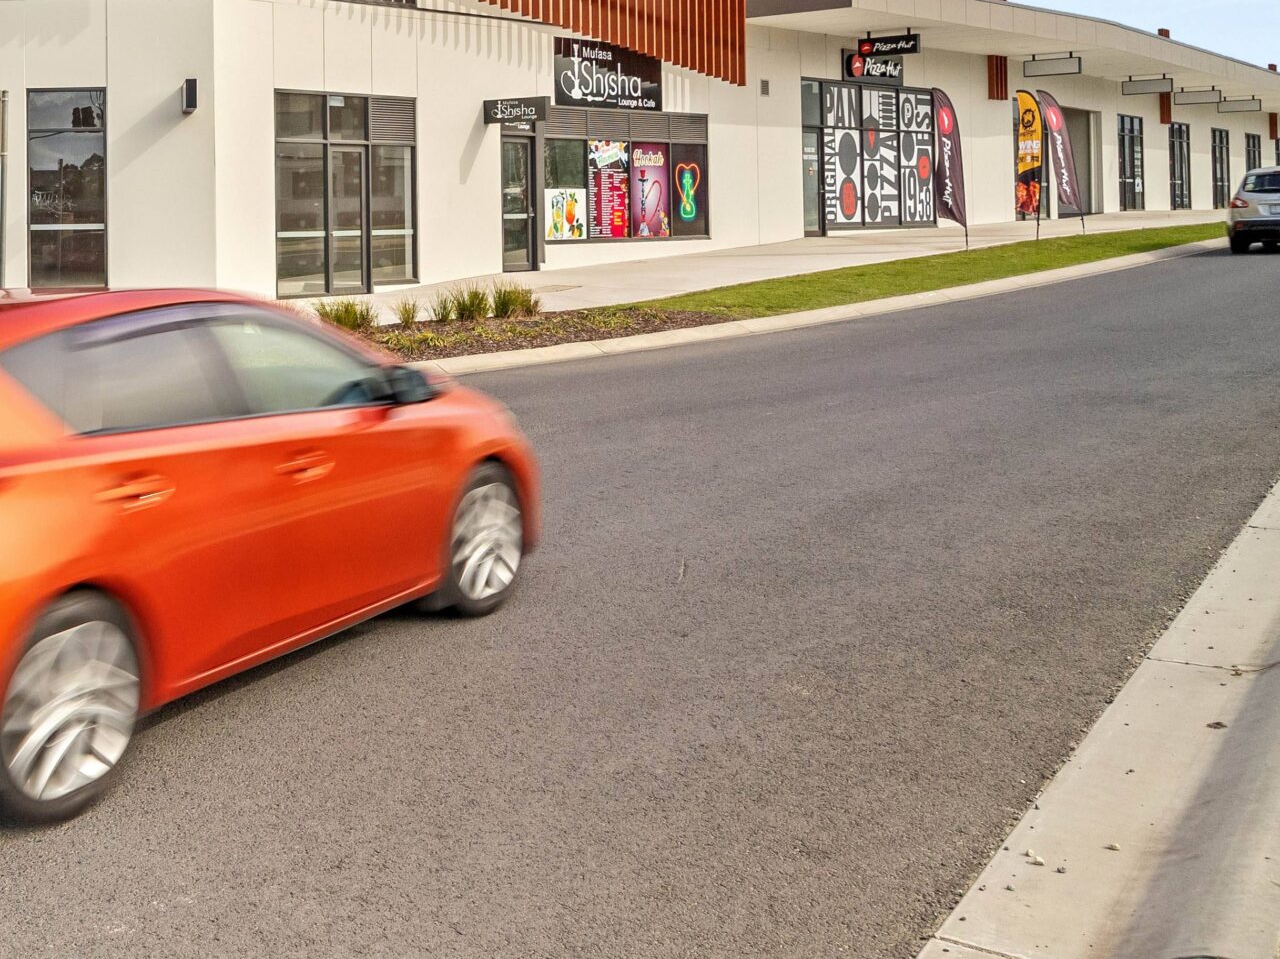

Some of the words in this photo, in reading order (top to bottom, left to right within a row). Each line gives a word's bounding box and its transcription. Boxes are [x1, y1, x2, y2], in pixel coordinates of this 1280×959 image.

[582, 46, 613, 60] Mufasa
[873, 42, 897, 53] Pizza
[897, 40, 915, 49] Hut
[863, 57, 886, 76] Pizza
[886, 60, 903, 77] Hut
[581, 60, 642, 101] Shisha
[501, 104, 536, 118] Shisha
[618, 97, 638, 108] Lounge
[643, 99, 656, 108] Cafe
[824, 85, 858, 128] PAN
[880, 132, 899, 219] PIZZA
